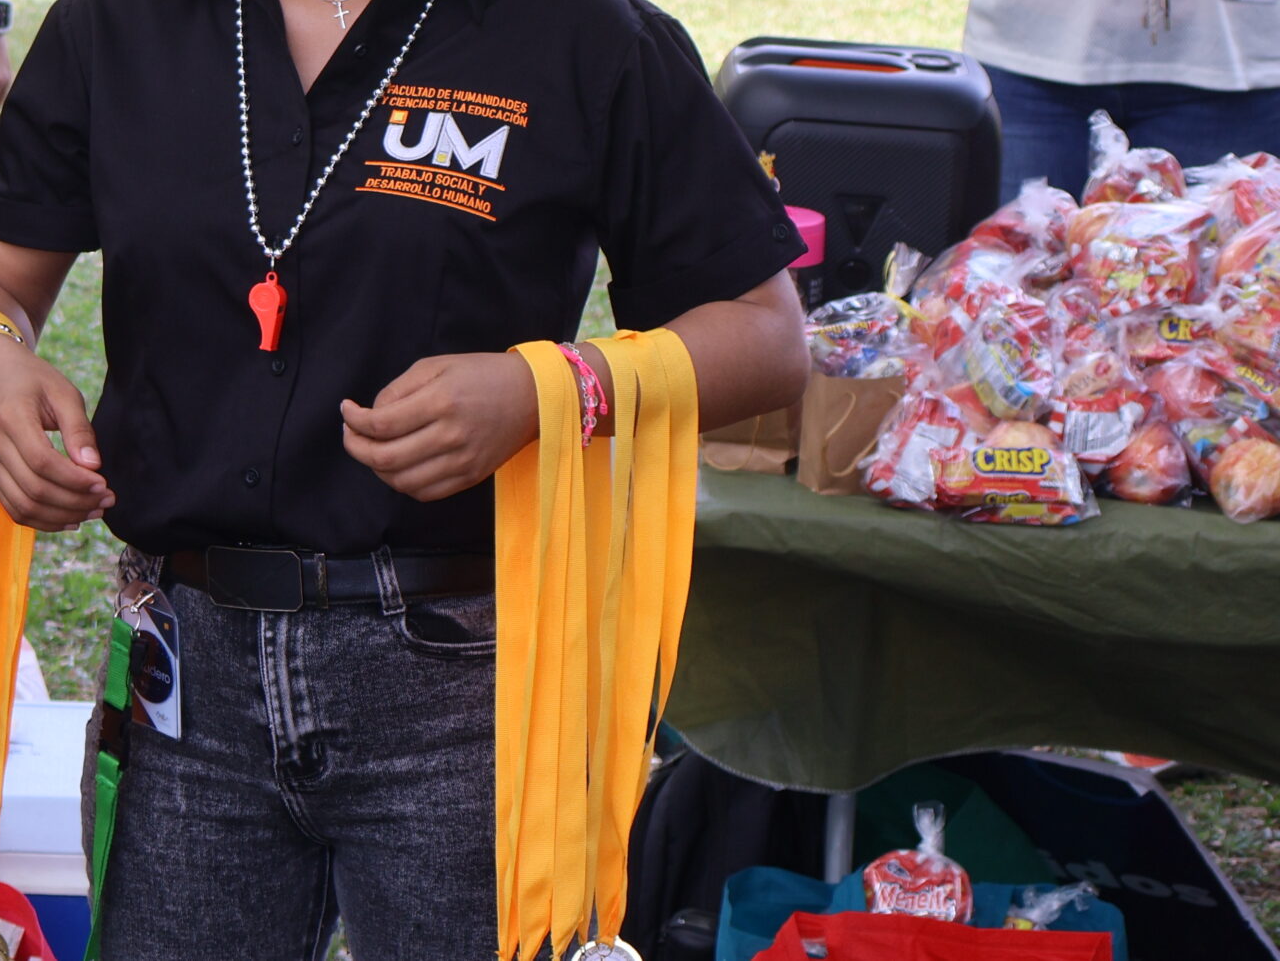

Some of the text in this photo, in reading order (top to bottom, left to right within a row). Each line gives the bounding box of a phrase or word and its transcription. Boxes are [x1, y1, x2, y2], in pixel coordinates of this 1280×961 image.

[381, 95, 528, 127] Y CIENCIAS DE LA EDUCACIÓN
[386, 84, 528, 113] FACULTAD DE HUMANIDADES
[383, 110, 510, 179] UM
[365, 178, 491, 213] DESARROLLO HUMANO
[380, 167, 487, 196] TRABAJO SOCIAL Y
[974, 447, 1051, 474] CRISP
